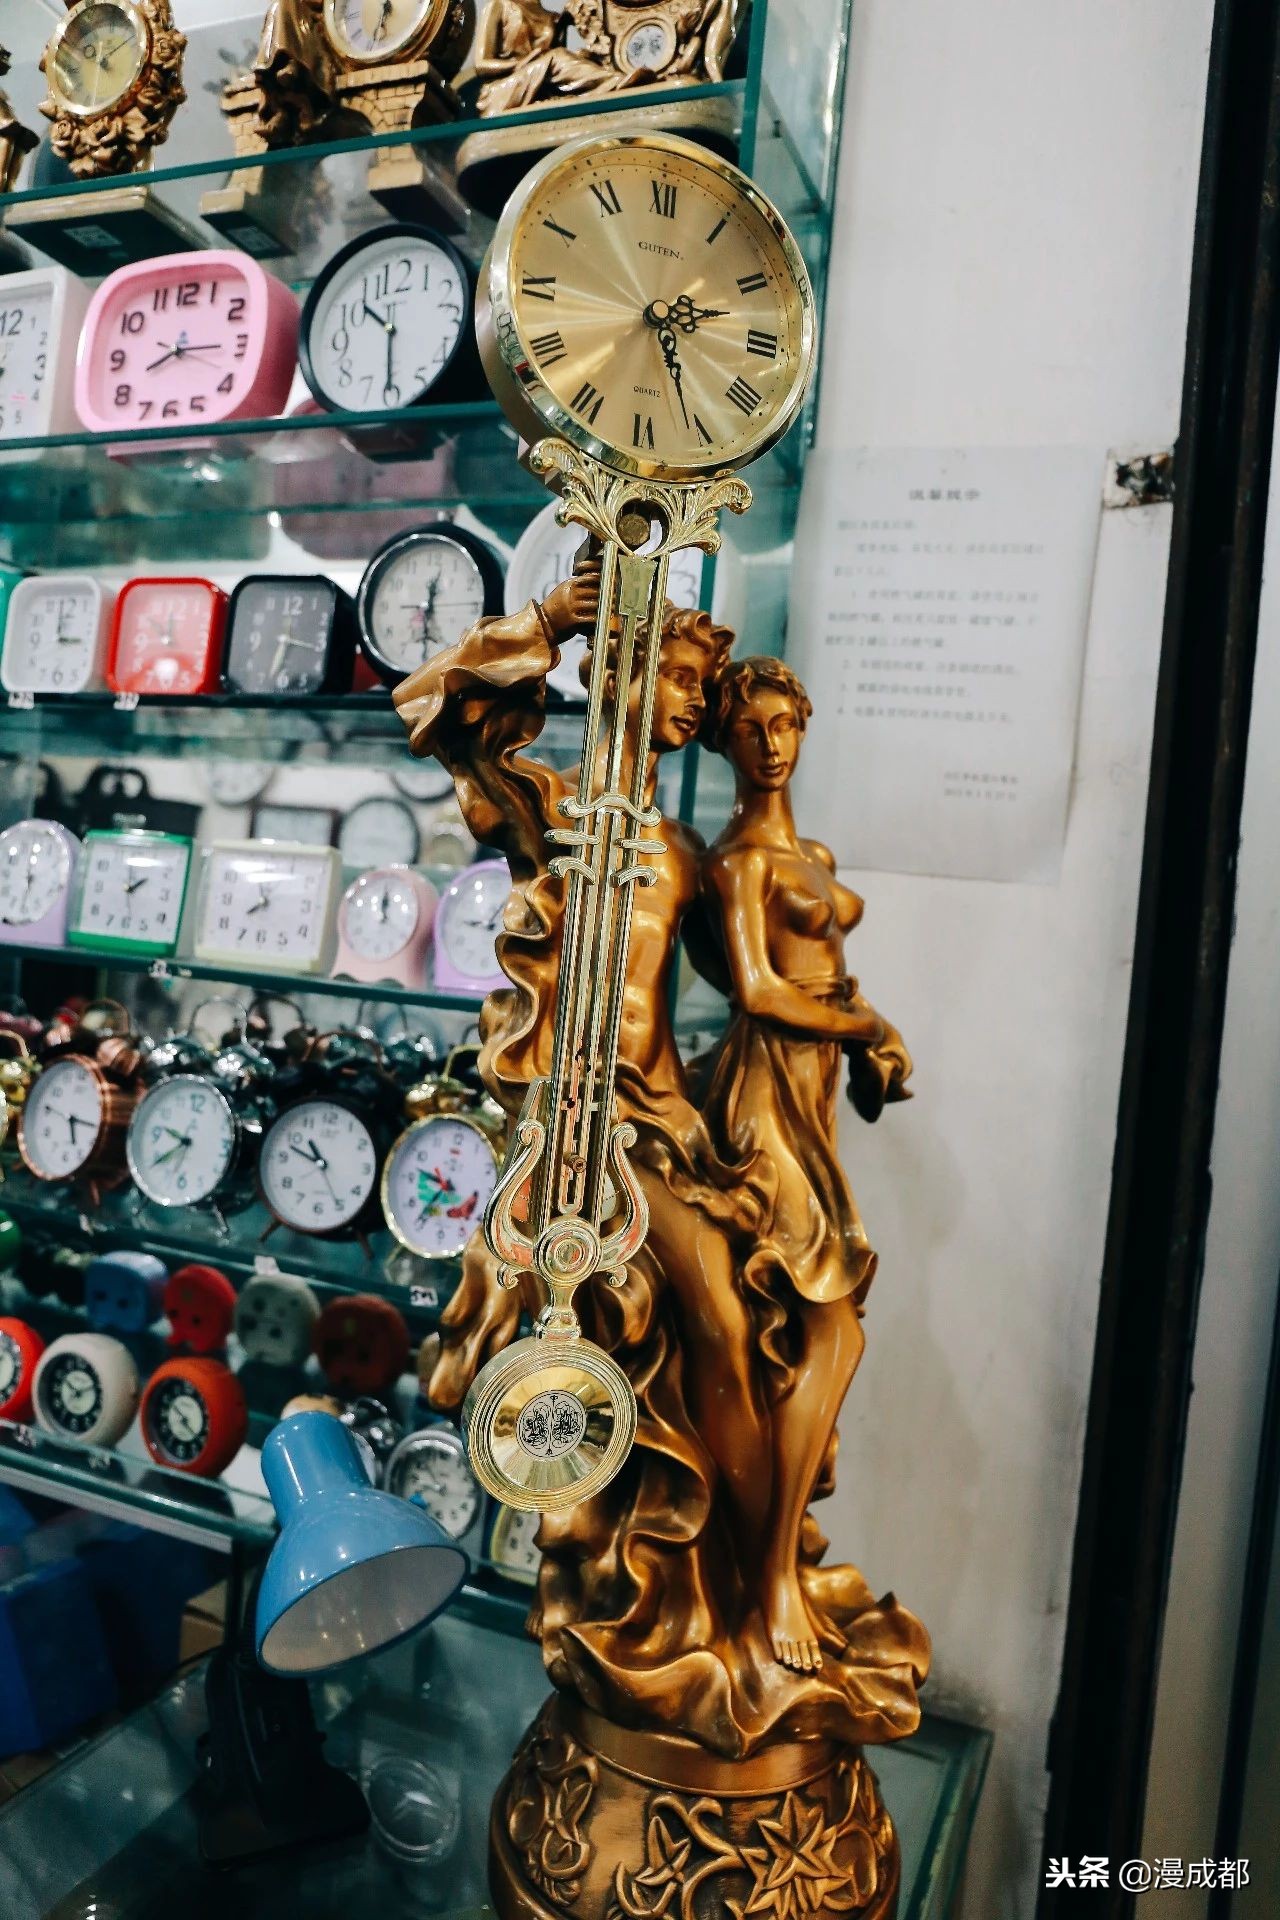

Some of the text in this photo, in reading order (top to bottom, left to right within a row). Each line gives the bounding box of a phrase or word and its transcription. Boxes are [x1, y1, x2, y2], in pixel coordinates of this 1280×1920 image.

[589, 179, 623, 218] XI
[650, 180, 677, 219] XII
[706, 217, 728, 245] I
[362, 275, 382, 303] 11
[383, 259, 411, 295] 12
[423, 264, 429, 291] 1
[521, 270, 556, 301] IX
[736, 272, 768, 296] II
[153, 288, 168, 311] 11
[176, 282, 200, 306] 12
[210, 281, 218, 303] 1
[0, 309, 24, 336] 12
[121, 311, 145, 334] 10
[227, 298, 246, 321] 2
[341, 298, 366, 332] 10
[332, 329, 349, 363] 9
[433, 337, 448, 363] 4
[747, 329, 778, 359] III
[110, 349, 126, 371] 9
[339, 359, 352, 387] 8
[114, 384, 131, 406] 8
[217, 372, 234, 393] 4
[361, 375, 374, 404] 7
[633, 385, 661, 398] QUARTZ
[138, 401, 152, 420] 7
[570, 382, 605, 425] VII
[633, 413, 655, 450] VI
[693, 414, 713, 447] V
[282, 596, 303, 615] 12
[250, 631, 261, 652] 9
[277, 670, 289, 688] 6
[190, 1094, 205, 1113] 12
[177, 1173, 187, 1190] 6
